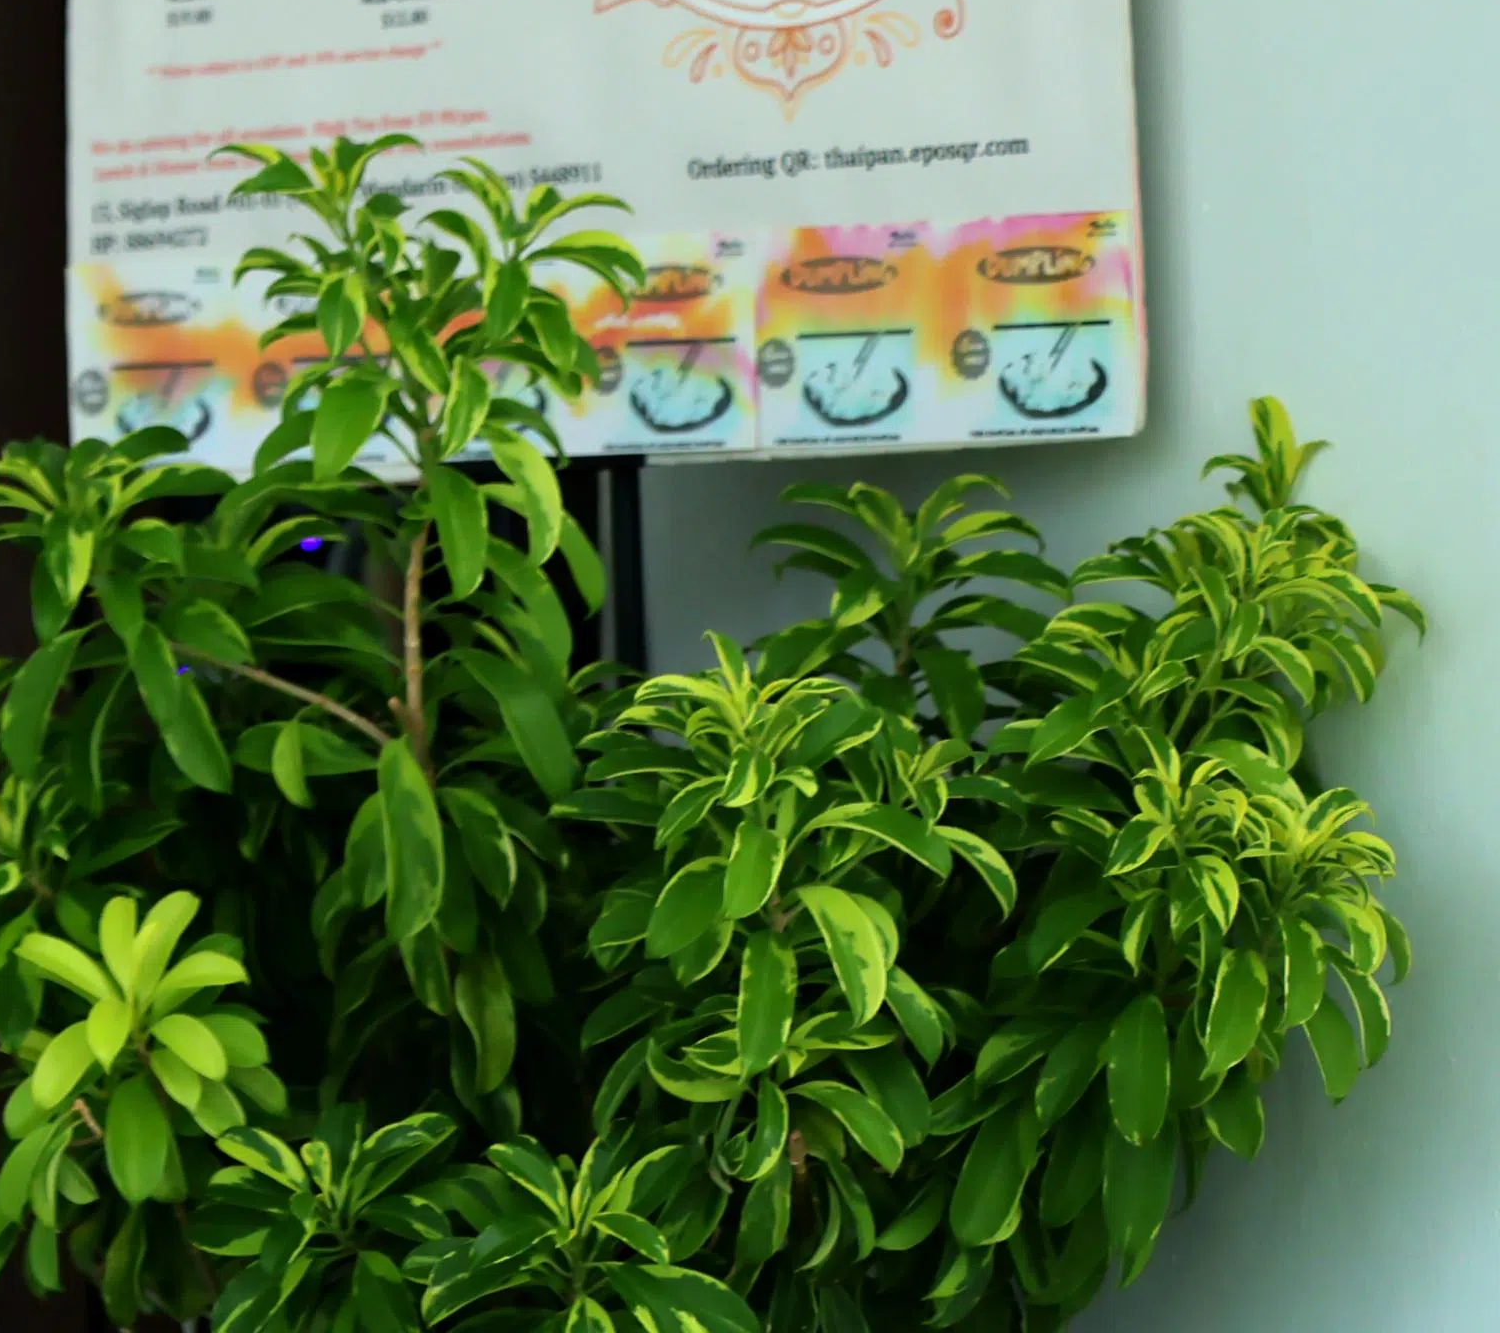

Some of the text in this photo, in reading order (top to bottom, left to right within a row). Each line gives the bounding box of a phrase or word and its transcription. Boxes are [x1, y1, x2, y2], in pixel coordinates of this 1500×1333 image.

[686, 138, 1029, 179] Ordering QR: thaipan.eposqr.com
